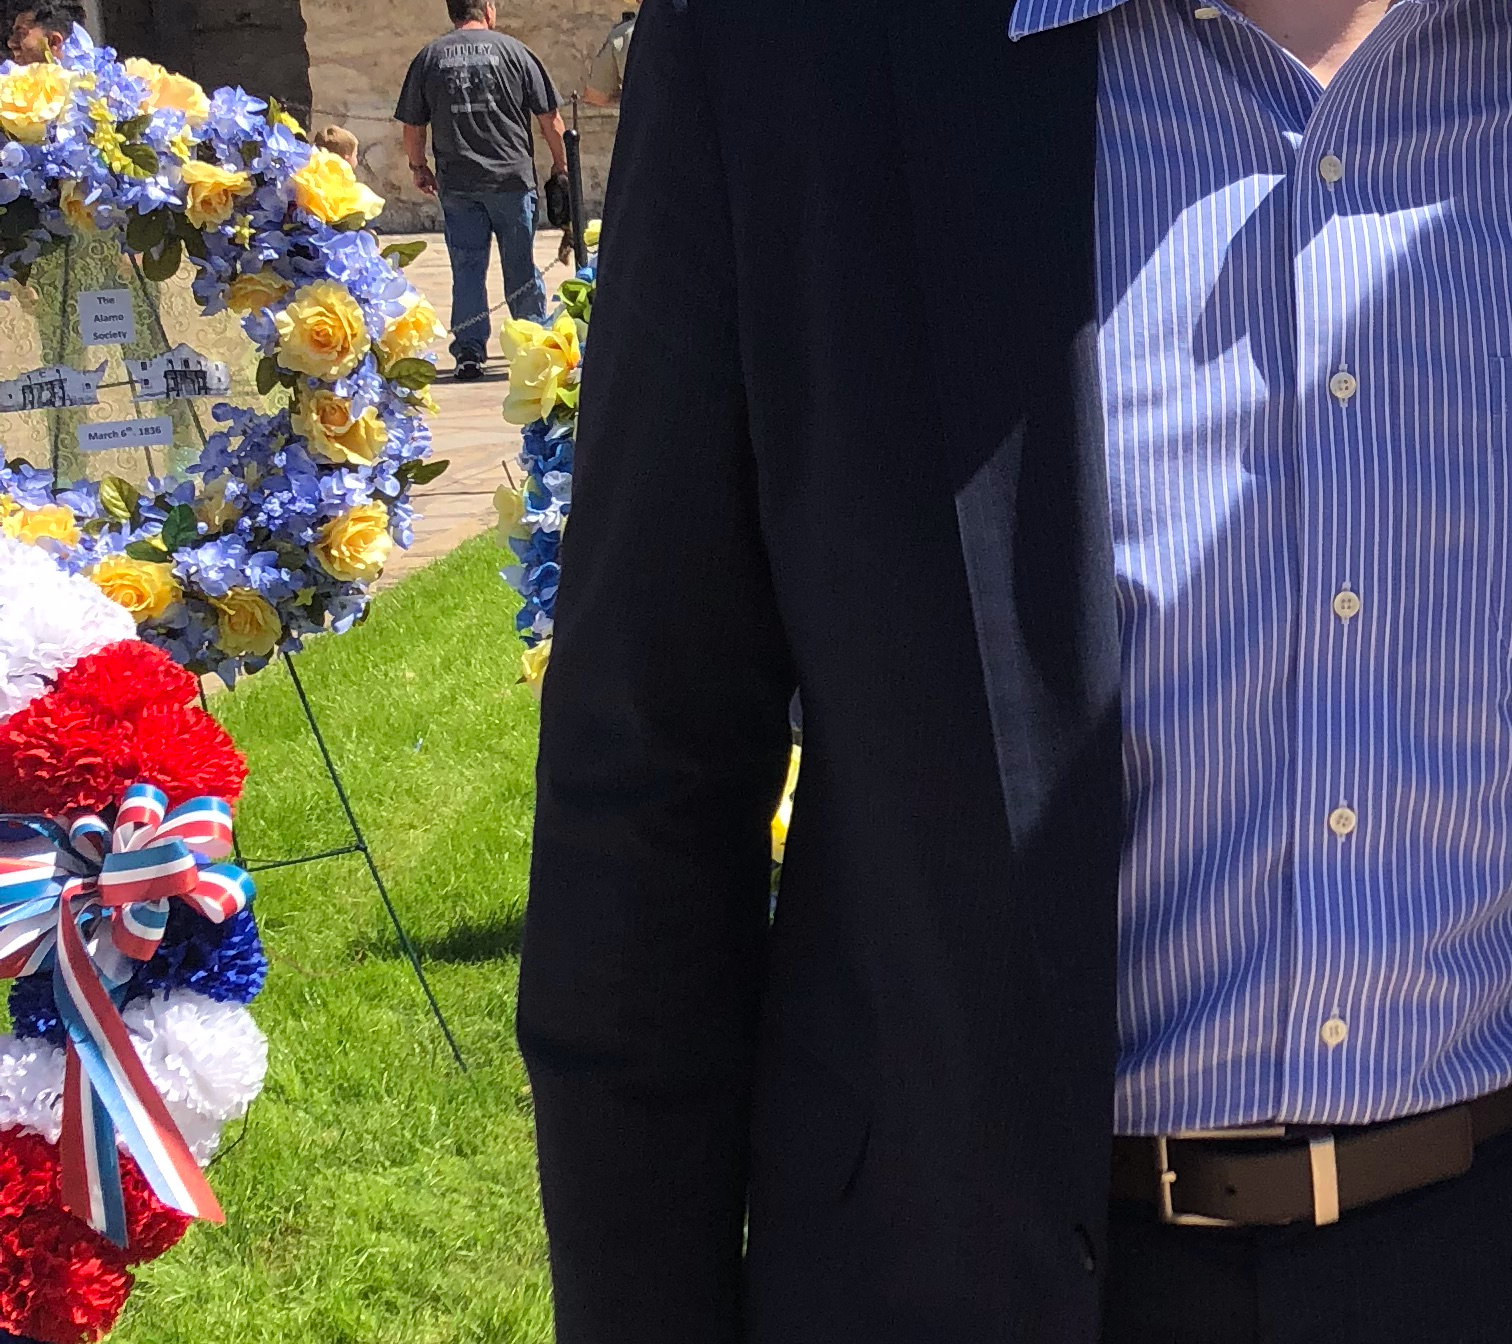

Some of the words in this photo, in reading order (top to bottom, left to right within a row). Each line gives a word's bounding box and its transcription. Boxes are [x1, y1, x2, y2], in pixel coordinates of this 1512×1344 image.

[97, 296, 115, 305] The
[93, 314, 125, 323] Alamo
[93, 330, 127, 340] Society
[88, 430, 119, 441] March
[139, 426, 162, 437] 1836
